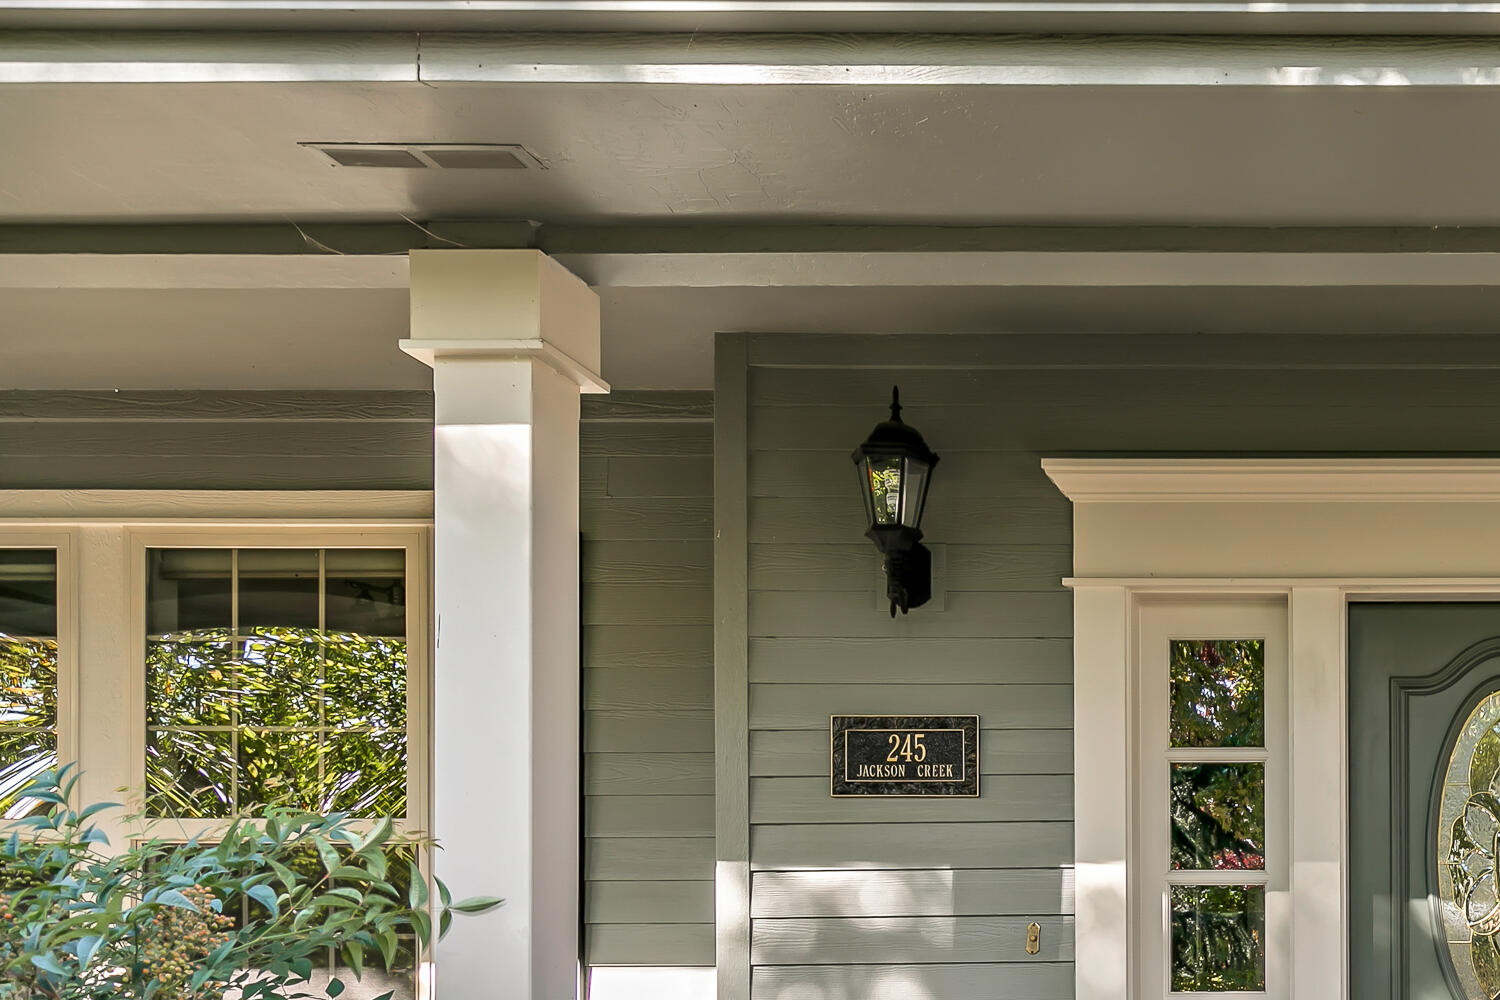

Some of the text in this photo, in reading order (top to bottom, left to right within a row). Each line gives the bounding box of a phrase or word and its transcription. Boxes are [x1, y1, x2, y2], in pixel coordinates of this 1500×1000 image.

[886, 733, 927, 763] 245
[856, 764, 953, 778] JACKSON CREEK
